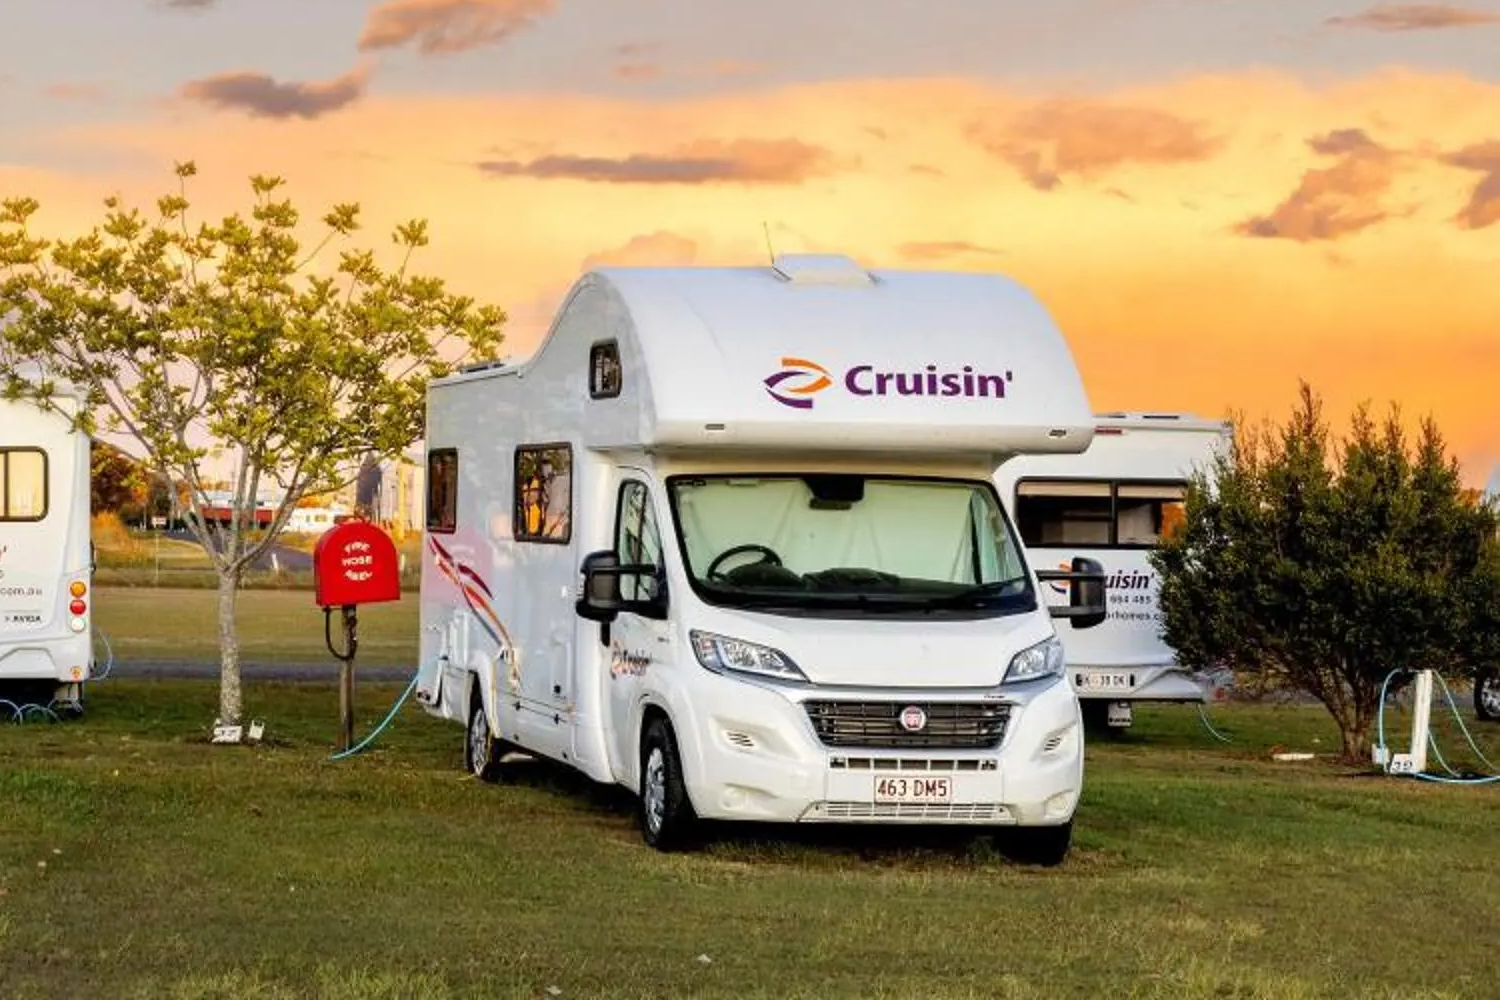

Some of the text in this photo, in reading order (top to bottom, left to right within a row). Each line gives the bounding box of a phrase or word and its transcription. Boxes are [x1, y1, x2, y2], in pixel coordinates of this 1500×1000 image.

[844, 364, 1013, 398] Cruisin'
[1104, 569, 1155, 589] uisin'
[877, 779, 947, 798] 463 DM5
